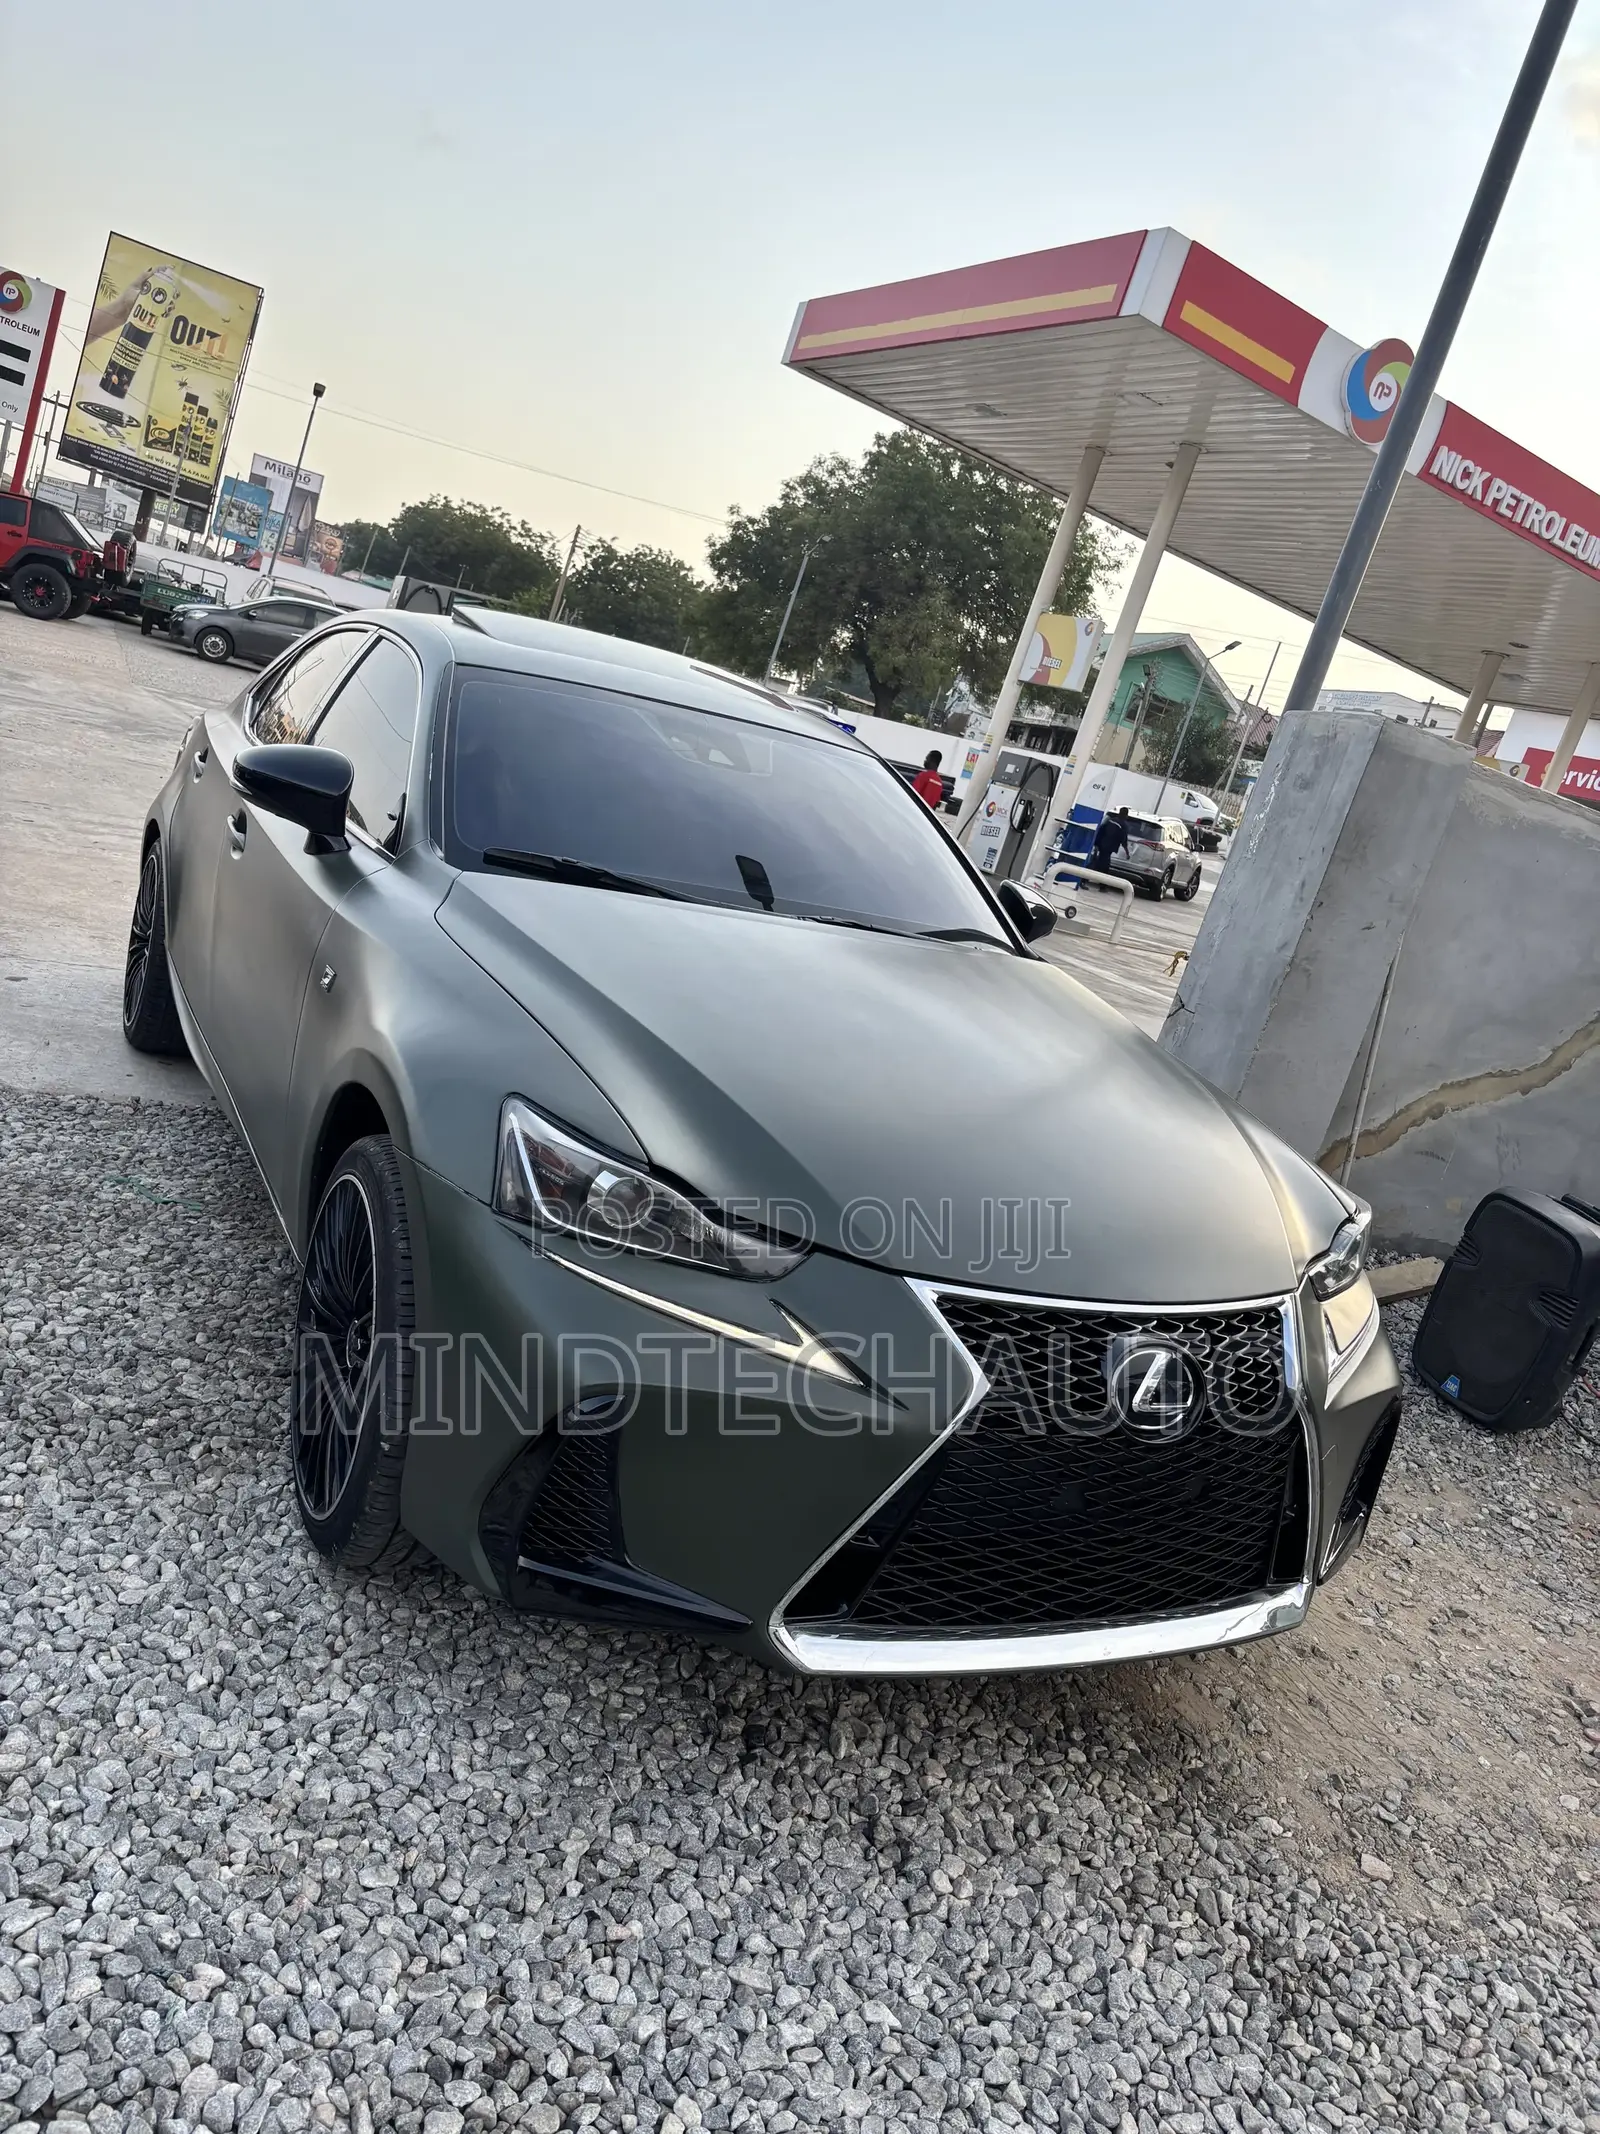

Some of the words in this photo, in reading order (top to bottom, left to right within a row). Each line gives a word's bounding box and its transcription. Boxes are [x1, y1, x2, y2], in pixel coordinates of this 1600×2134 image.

[170, 315, 229, 361] OUT!
[1429, 446, 1491, 501] NICK
[1042, 656, 1062, 669] DIESEL
[981, 825, 1000, 837] DIESEL
